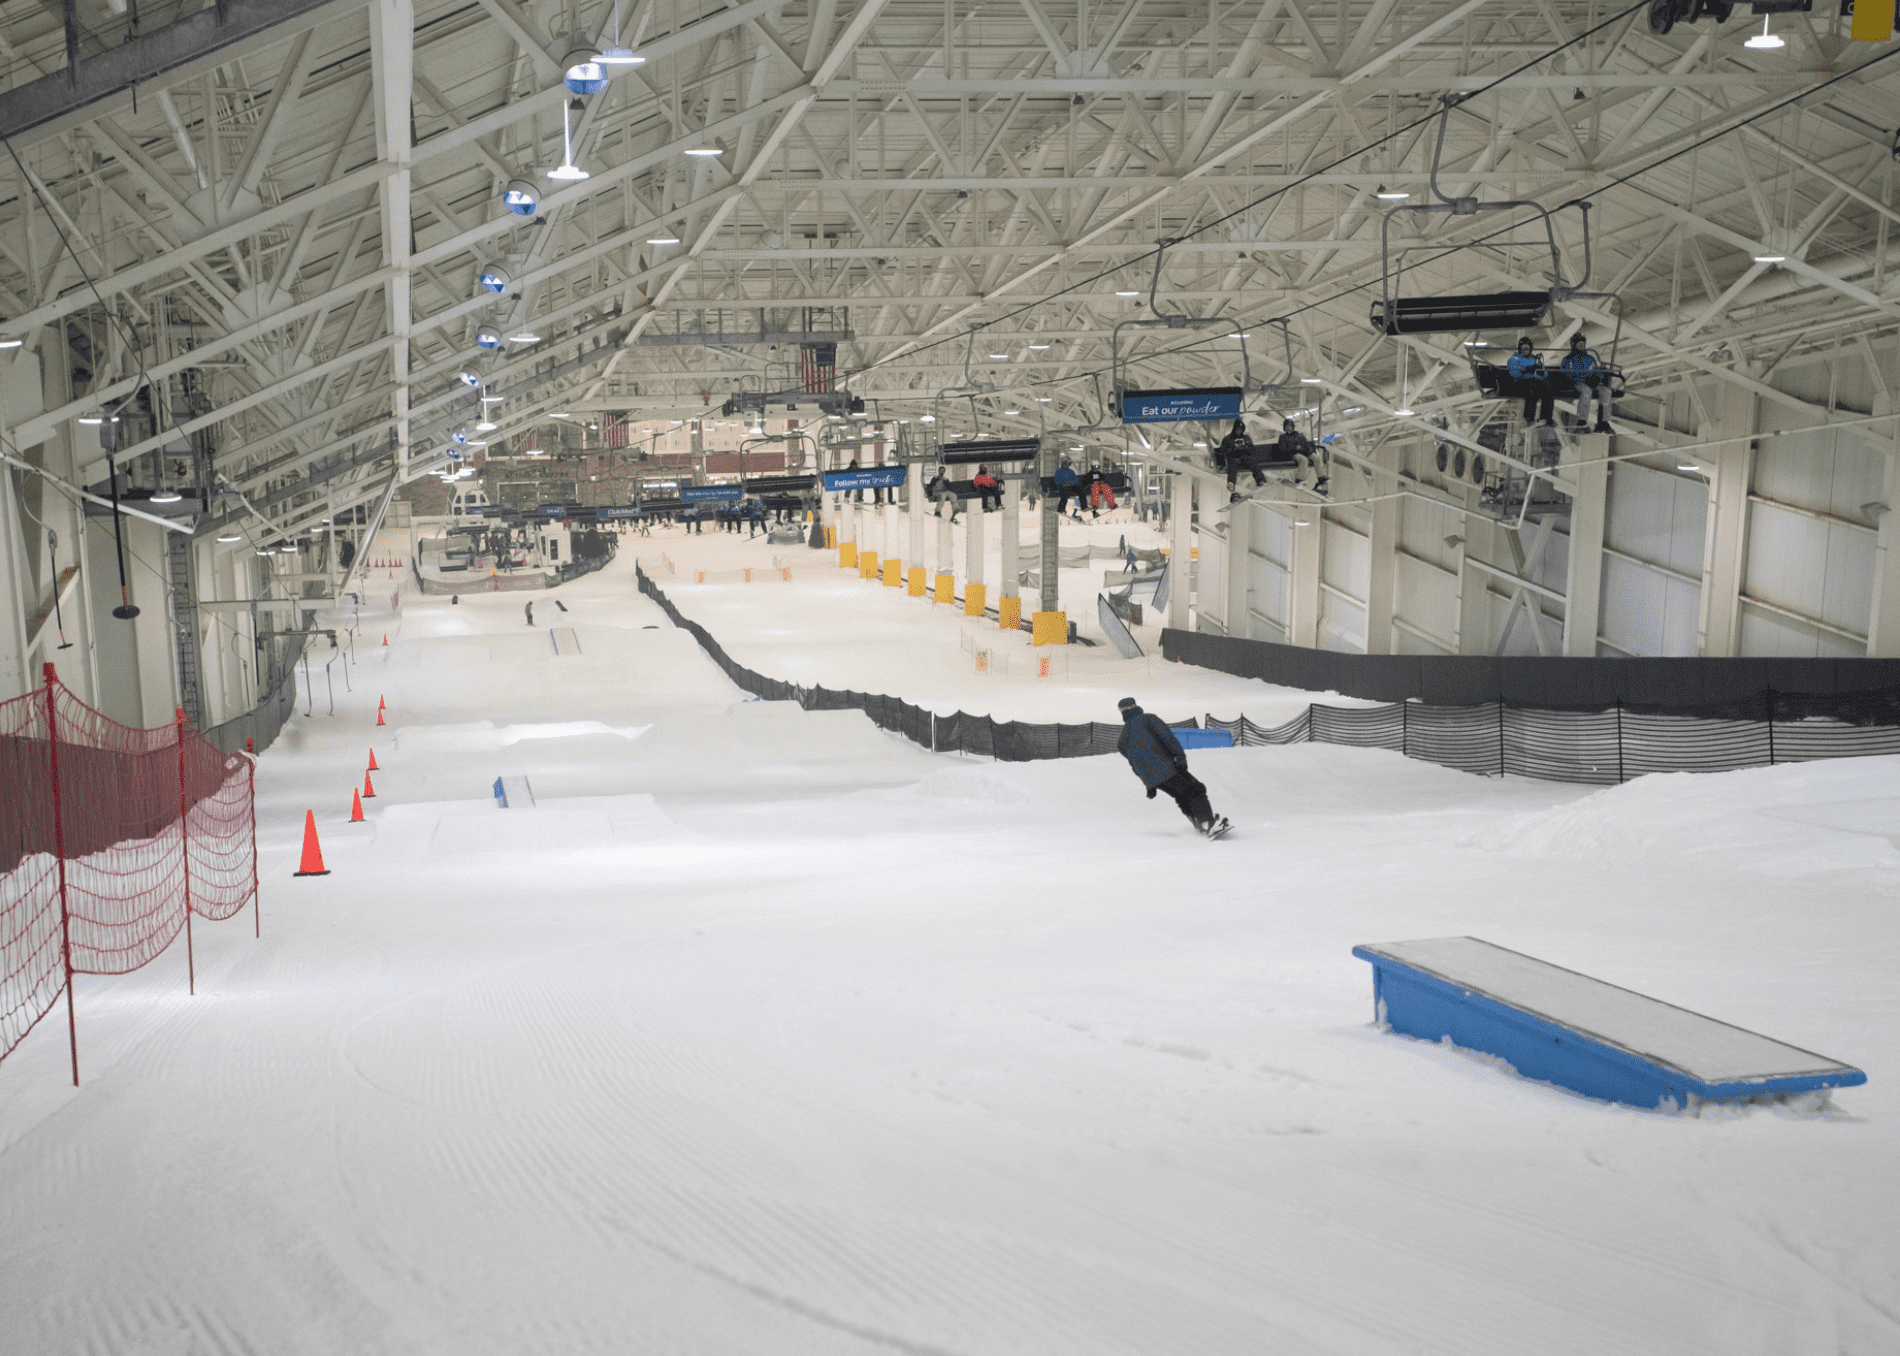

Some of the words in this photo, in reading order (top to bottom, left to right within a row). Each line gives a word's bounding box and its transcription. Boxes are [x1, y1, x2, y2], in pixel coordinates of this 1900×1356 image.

[1142, 406, 1159, 416] Eat
[1161, 407, 1178, 415] our
[1177, 401, 1221, 421] powder
[834, 479, 858, 487] Follow
